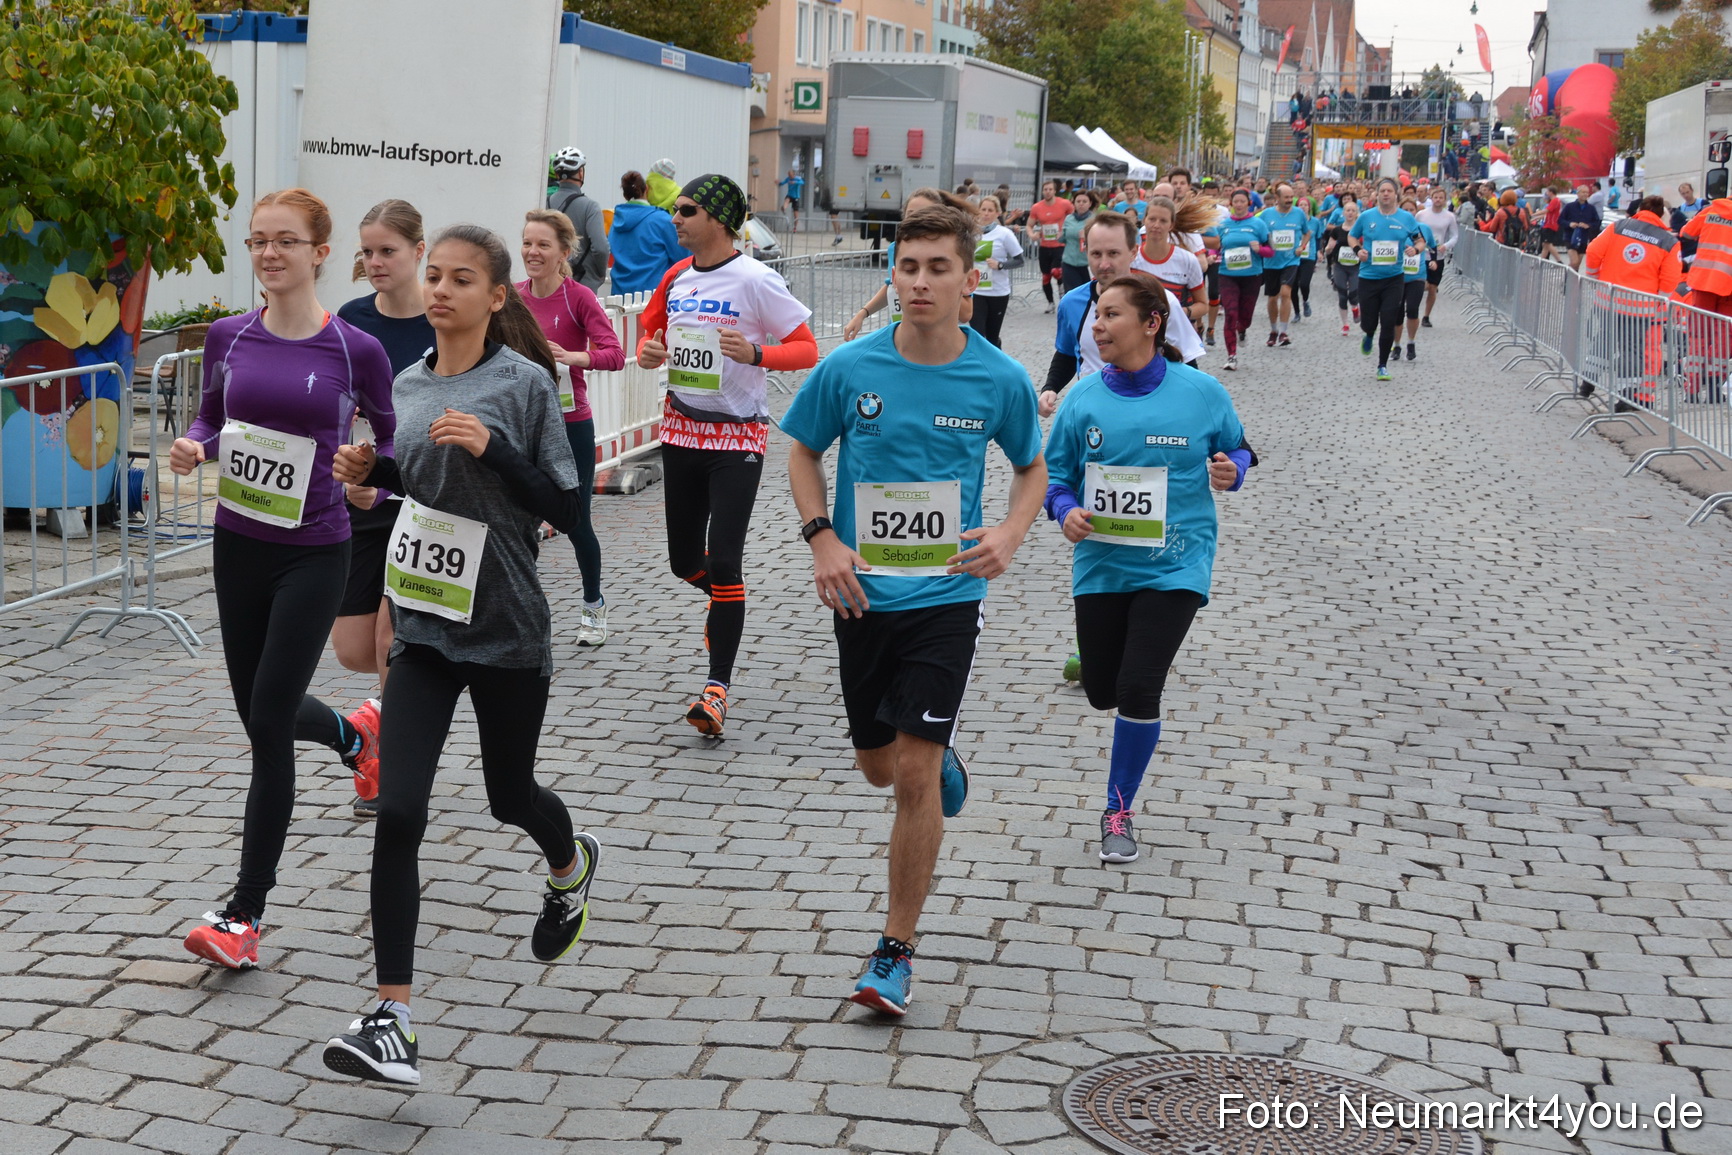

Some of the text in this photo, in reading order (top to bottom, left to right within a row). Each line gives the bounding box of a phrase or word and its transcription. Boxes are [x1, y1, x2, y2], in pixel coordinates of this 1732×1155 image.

[798, 86, 818, 106] D
[1365, 127, 1393, 138] ZIEL
[302, 137, 502, 167] www.bmw-laufsport.de
[1375, 247, 1395, 256] 5236
[697, 314, 738, 326] energie
[673, 346, 713, 370] 5030
[680, 373, 699, 383] Martin
[856, 421, 881, 432] PARTL
[934, 415, 985, 430] BOCK
[253, 435, 286, 450] BOCK
[1145, 435, 1188, 446] BOCK
[230, 449, 295, 490] 5078
[240, 489, 272, 507] Natalie
[894, 490, 930, 499] BOCK
[1094, 488, 1152, 515] 5125
[418, 516, 455, 533] BOCK
[871, 511, 945, 540] 5240
[1109, 521, 1135, 532] Joana
[395, 532, 466, 578] 5139
[882, 548, 934, 562] Sebastian
[399, 576, 444, 598] Vanessa
